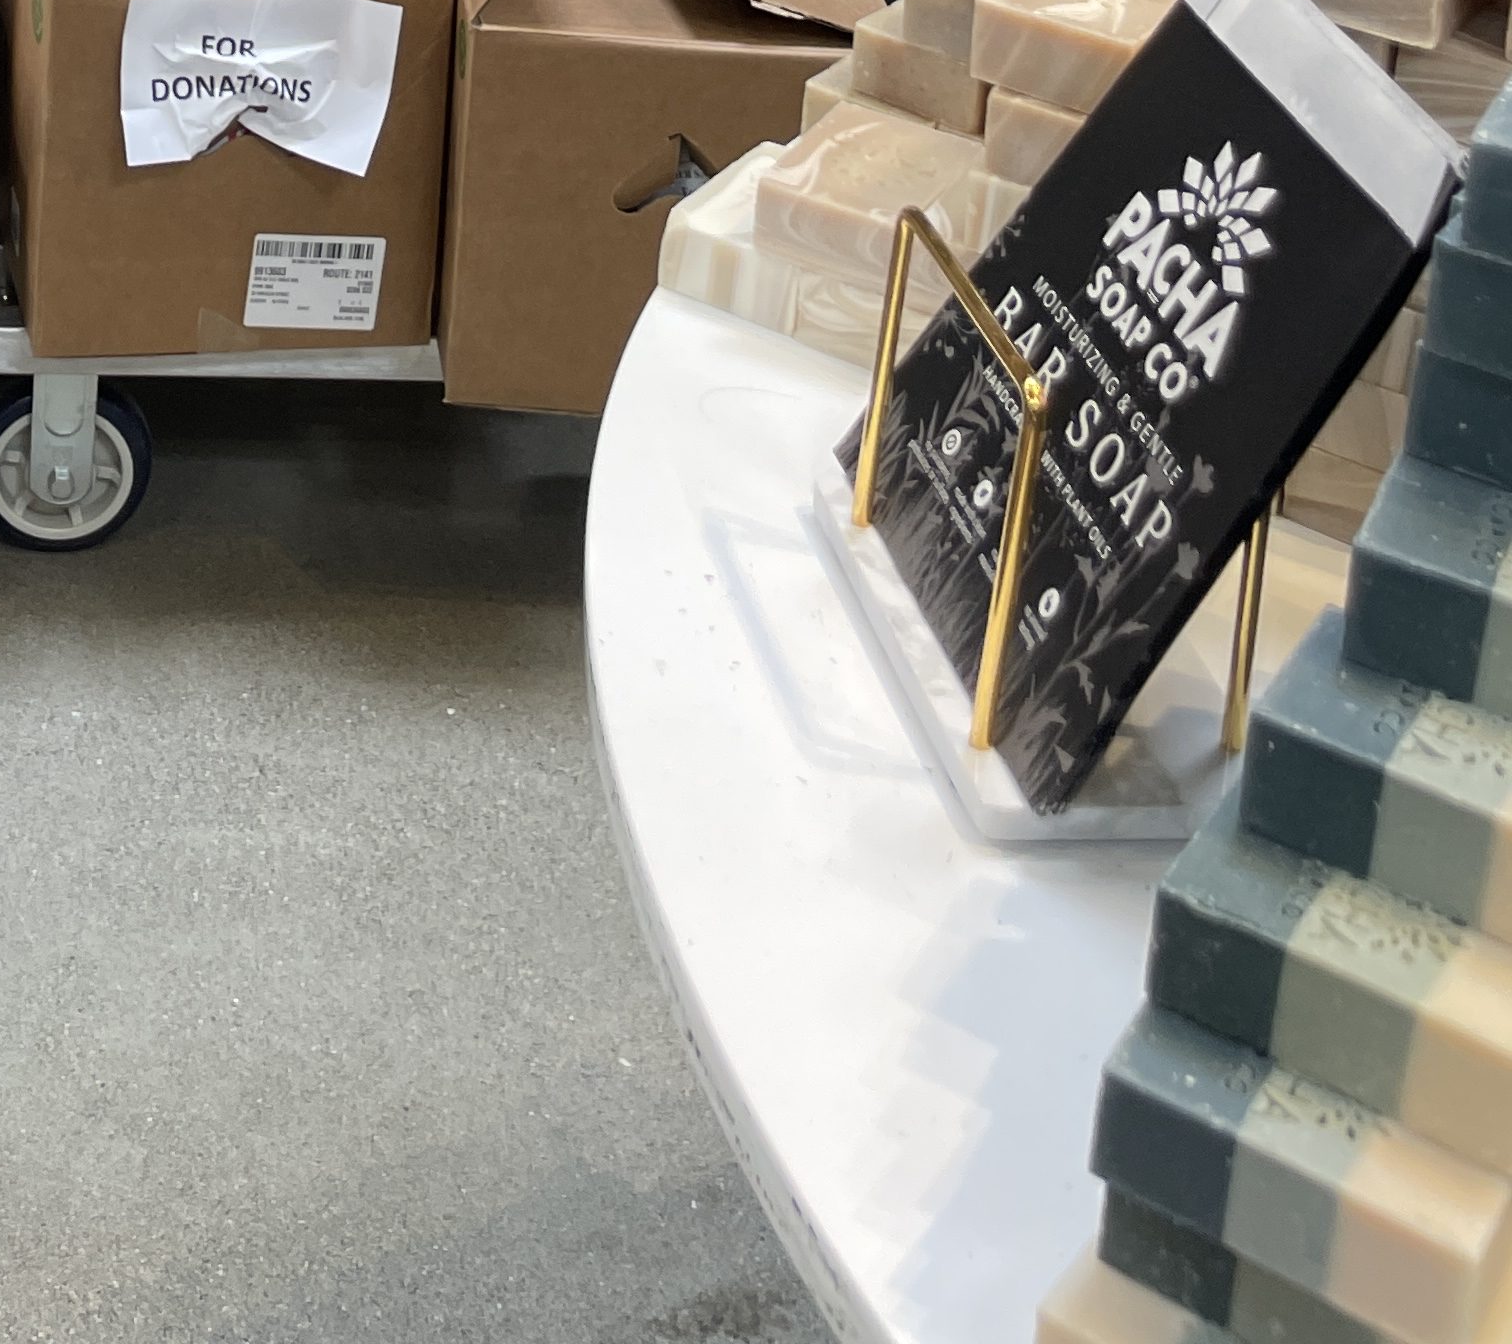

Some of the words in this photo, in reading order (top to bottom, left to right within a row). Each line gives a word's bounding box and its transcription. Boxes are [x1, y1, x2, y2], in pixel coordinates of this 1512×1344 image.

[151, 73, 313, 103] DONATIONS
[201, 35, 258, 58] FOR
[322, 268, 353, 279] ROUTE:
[1086, 263, 1152, 353] SOAP
[1103, 190, 1239, 379] PACHA
[995, 287, 1069, 395] BAR
[1064, 398, 1173, 548] SOAP
[1032, 275, 1122, 397] MOISTURIZING
[1116, 392, 1133, 416] &
[1131, 409, 1184, 488] GENTLE
[1039, 449, 1065, 486] WITH
[1061, 476, 1095, 529] PLANT
[1087, 521, 1113, 561] OILS
